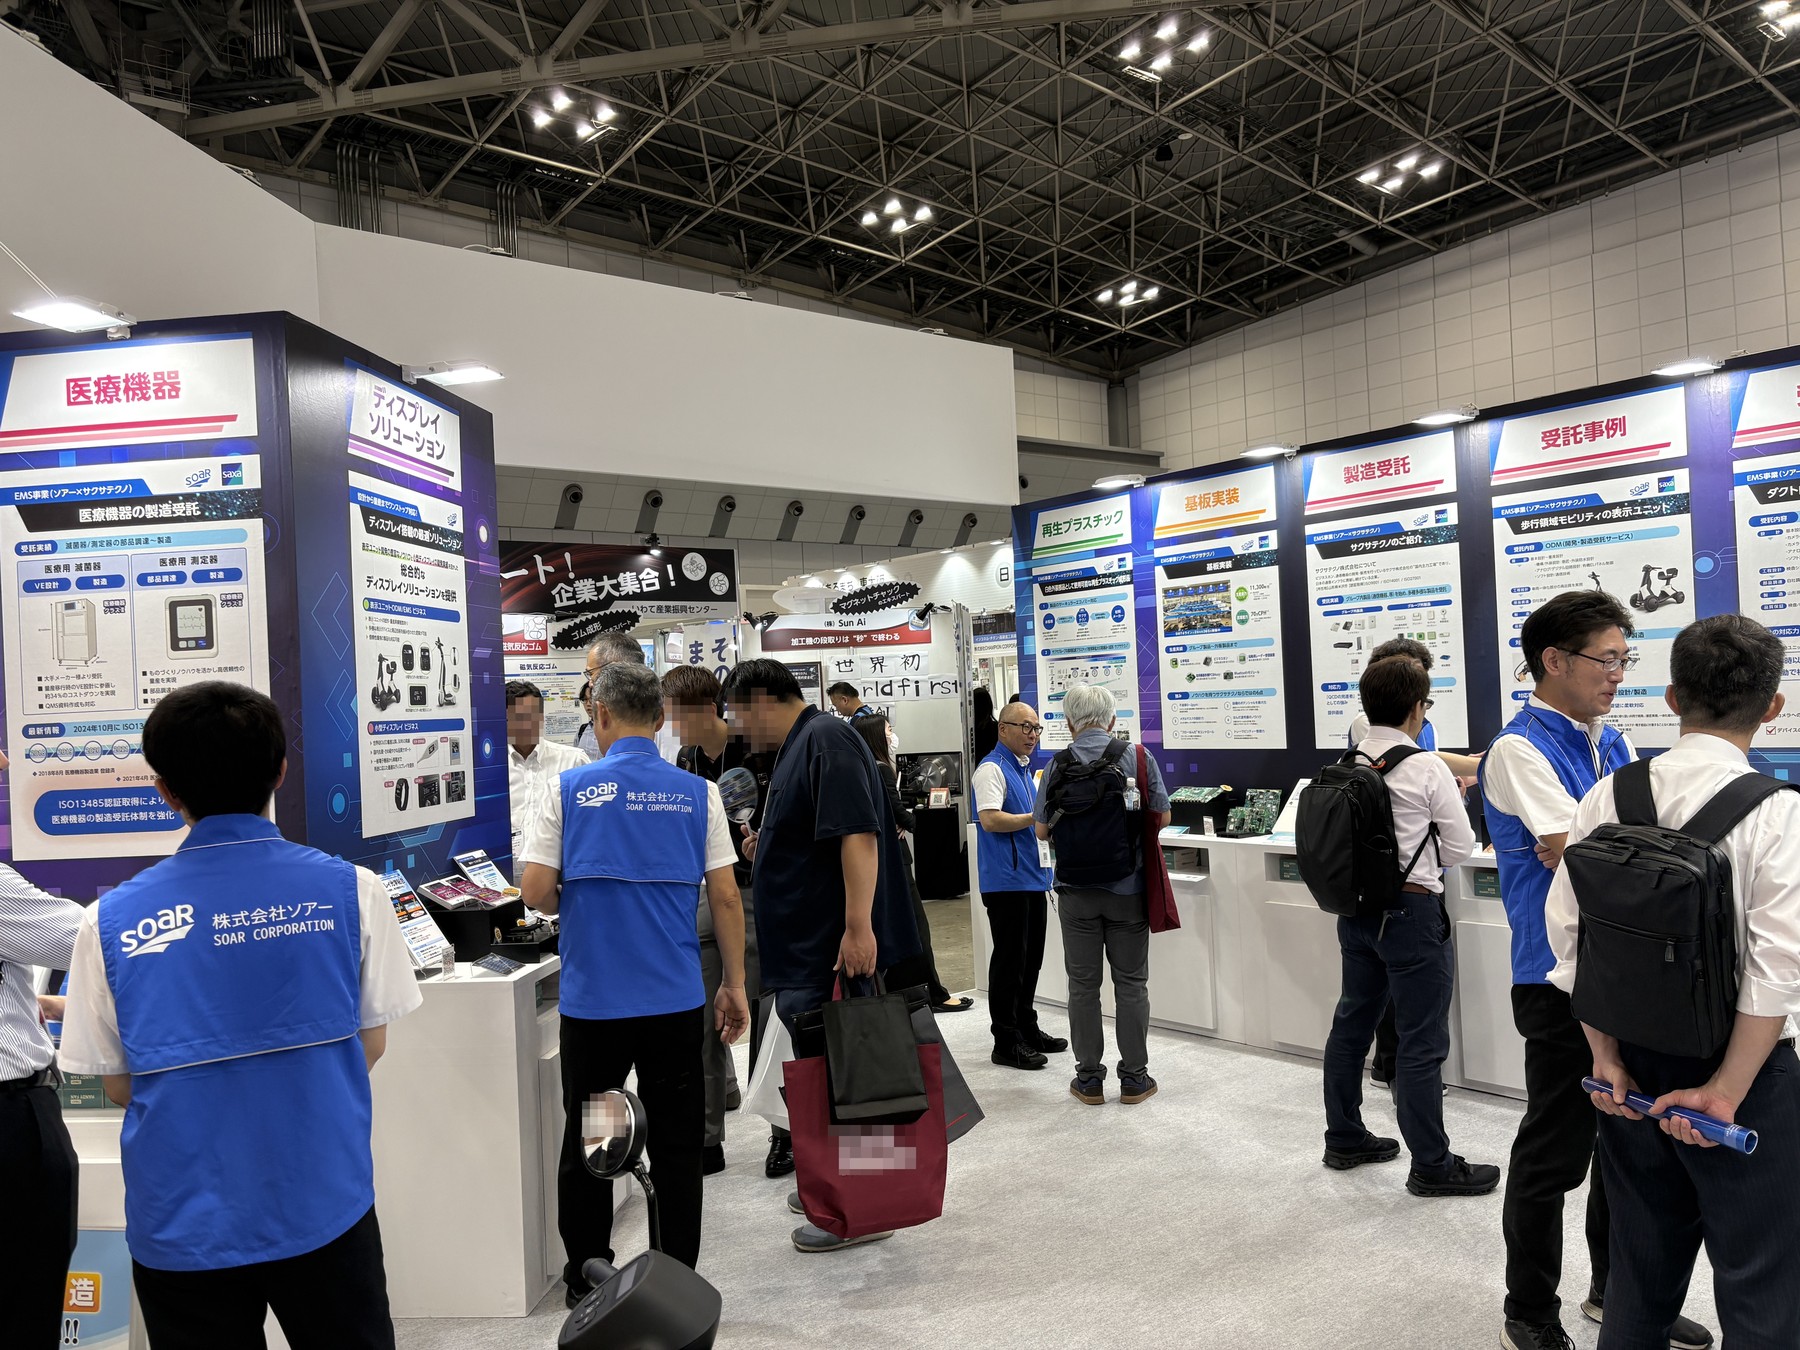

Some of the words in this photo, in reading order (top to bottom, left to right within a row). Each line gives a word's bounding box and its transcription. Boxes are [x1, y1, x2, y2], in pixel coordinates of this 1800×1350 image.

[66, 370, 182, 407] 医療機器
[372, 384, 442, 434] ディスプレイ
[368, 411, 447, 461] ソリューション
[1540, 415, 1627, 451] 受託事例
[222, 469, 242, 479] saxa
[1343, 455, 1411, 485] 製造受託
[1746, 470, 1800, 482] EMS事業(ソアー
[1184, 487, 1241, 513] 基板実装
[1767, 487, 1800, 499] ダクト
[79, 501, 202, 523] 医療機器の製造受託
[1520, 503, 1671, 531] 歩行領域モビリティの表示ユニット
[1041, 510, 1124, 539] 再生プラスチック
[1760, 515, 1788, 525] 受託内容
[368, 515, 463, 550] ディスプレイ搭載の最適ソリューション
[20, 543, 52, 553] 受託実績
[1350, 534, 1423, 552] サクサテクノのご紹介
[1513, 544, 1535, 553] 受託内容
[159, 557, 186, 567] 医療用
[190, 555, 219, 565] 測定器
[1206, 560, 1233, 572] 基板実装
[44, 564, 71, 574] 医療用
[209, 570, 225, 580] 製造
[399, 564, 426, 580] 総合的な
[92, 577, 108, 587] 製造
[147, 573, 177, 583] 部品調達
[34, 581, 60, 590] VE設計
[366, 575, 458, 603] ディスプレイソリューションを提供
[551, 563, 677, 608] 企業大集合!
[838, 585, 901, 610] マグネットチャック
[878, 591, 911, 606] のエキスパート
[838, 619, 855, 628] Sun
[856, 617, 867, 627] Ai
[571, 621, 603, 641] ゴム成形
[790, 633, 850, 646] 加工機の段取りは
[870, 631, 901, 642] で終わる
[519, 663, 558, 671] 磁気反応ゴム
[28, 726, 60, 736] 最新情報
[73, 724, 120, 733] 2024年10月に
[122, 722, 145, 731] ISO13
[58, 796, 166, 809] ISO13485認証取得により
[625, 790, 693, 803] 株式会社ソアー
[625, 802, 644, 812] SOAR
[647, 803, 693, 814] CORPORATION
[51, 811, 176, 825] 医療機器の製造受託体制を強化
[211, 900, 334, 931] 株式会社ソアー
[213, 929, 246, 947] SOAR
[253, 918, 335, 942] CORPORATION
[68, 1278, 96, 1308] 造
